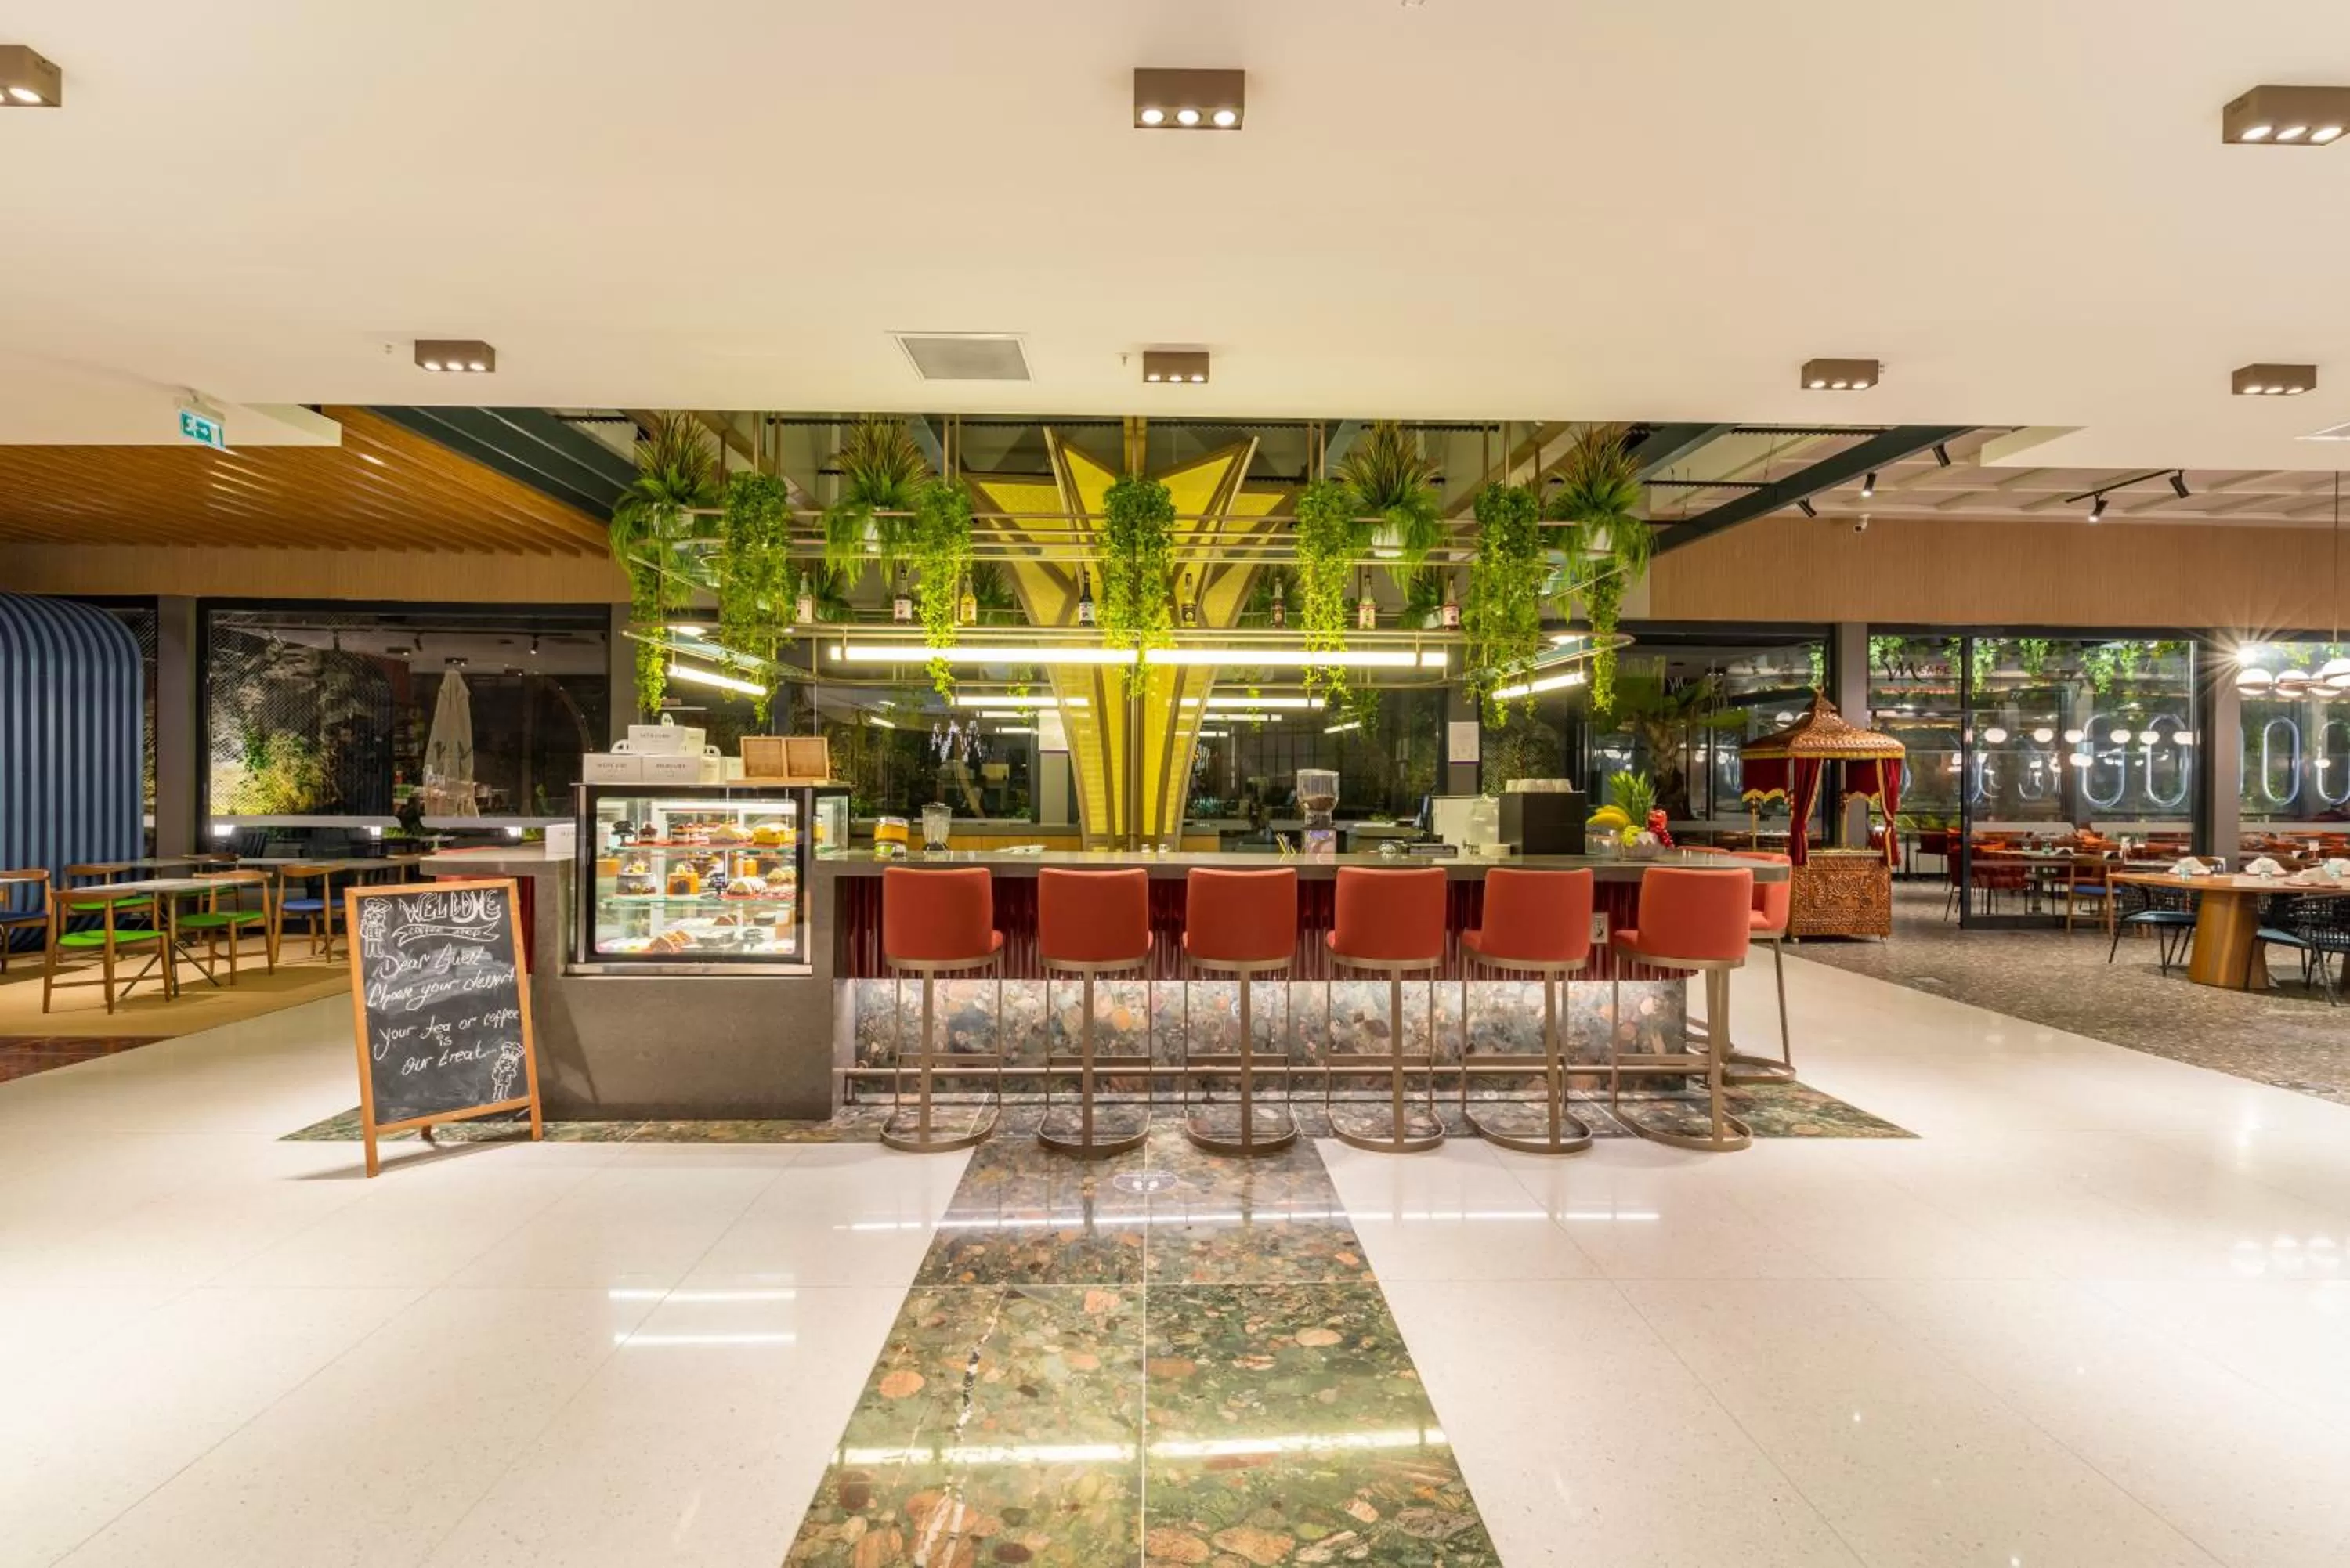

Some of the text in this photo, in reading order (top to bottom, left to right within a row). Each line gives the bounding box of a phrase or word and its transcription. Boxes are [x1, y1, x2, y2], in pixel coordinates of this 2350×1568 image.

[399, 890, 502, 923] WELCOME
[372, 942, 485, 979] Dear Guest
[406, 980, 460, 1011] your
[374, 1008, 519, 1061] your tea or coffee
[436, 1034, 452, 1047] is
[401, 1057, 433, 1076] our
